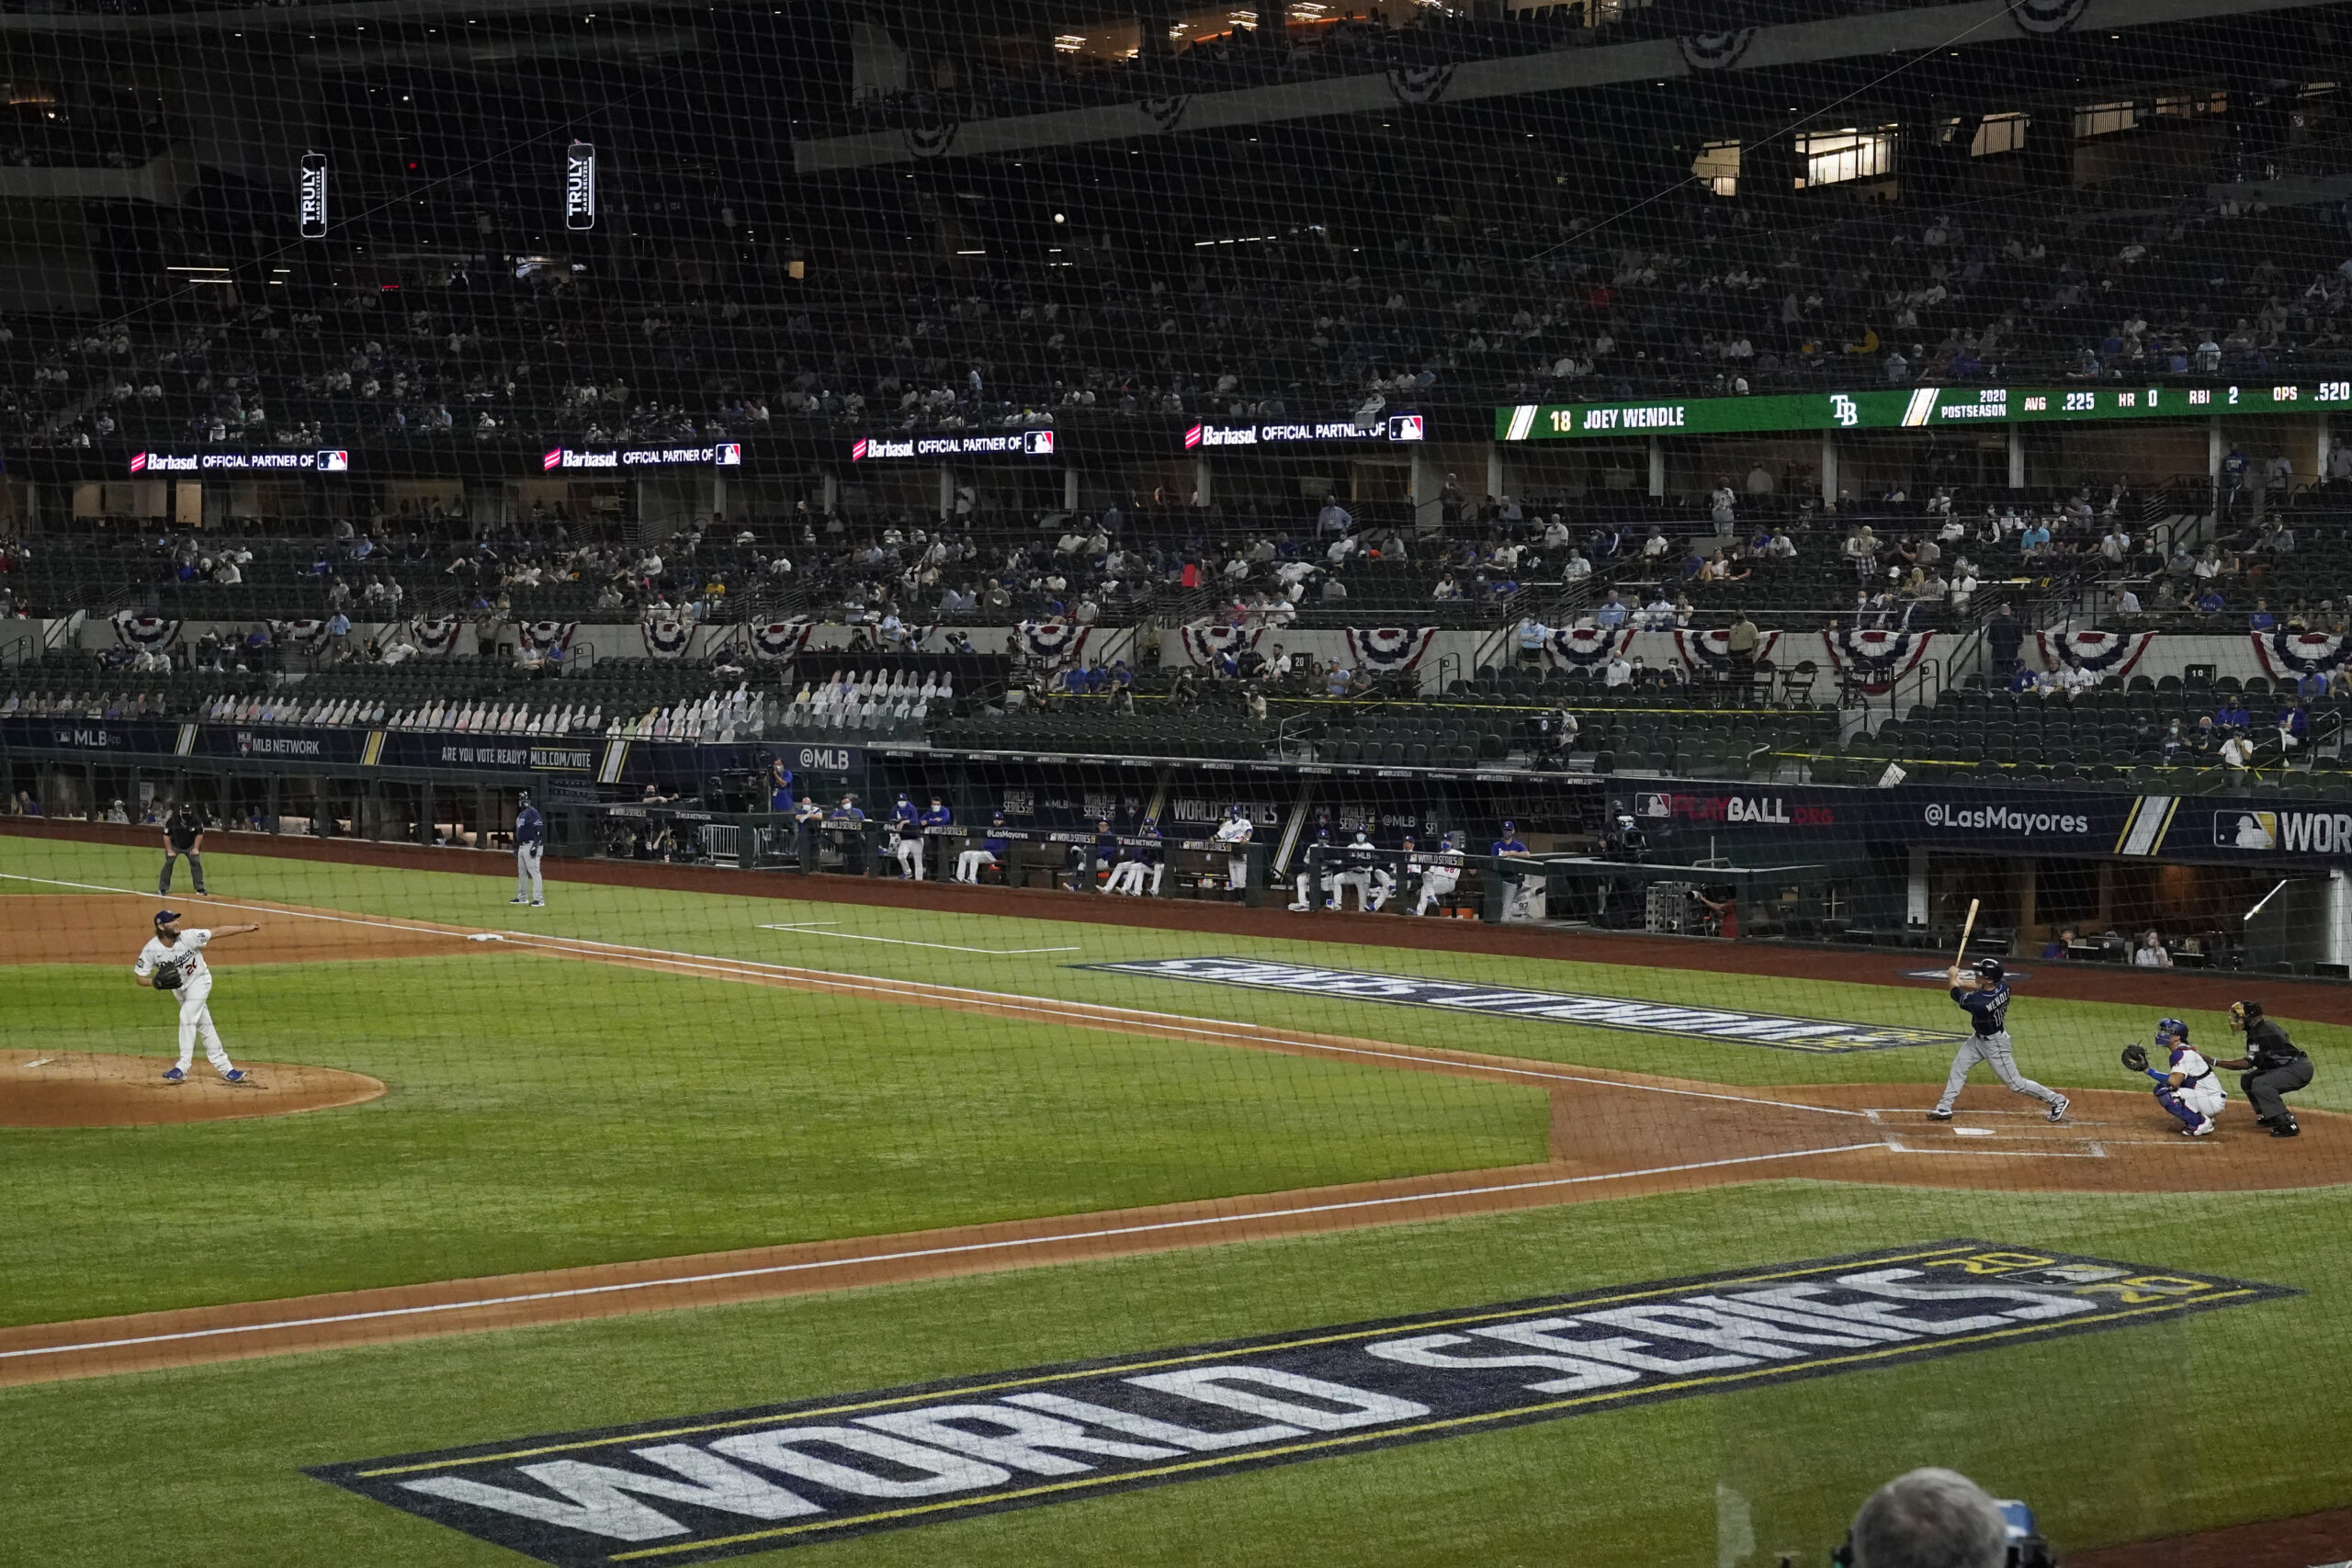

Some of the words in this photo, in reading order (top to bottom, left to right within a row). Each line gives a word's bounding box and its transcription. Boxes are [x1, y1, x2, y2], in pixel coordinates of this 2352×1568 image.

[569, 156, 582, 217] TRULY
[302, 166, 316, 225] TRULY
[1980, 389, 2007, 403] 2020
[2119, 393, 2135, 407] HR
[2148, 389, 2157, 407] 0
[2188, 389, 2211, 404] RBI
[2228, 386, 2238, 404] 2
[2273, 386, 2297, 401] OPS
[2314, 382, 2350, 400] .520
[2024, 397, 2046, 412] AVG
[2062, 392, 2095, 411] .225
[1941, 404, 2007, 419] POSTSEASON
[1550, 411, 1571, 432] 18
[1583, 409, 1619, 430] JOEY
[1623, 407, 1685, 428] WENDLE
[1203, 425, 1258, 446] Barbasol
[1261, 424, 1314, 441] OFFICIAL
[867, 439, 914, 457] Barbasol
[918, 439, 961, 454] OFFICIAL
[963, 437, 1006, 452] PARTNER
[1008, 436, 1022, 450] OF
[147, 453, 198, 470] Barbasol
[202, 455, 249, 468] OFFICIAL
[252, 455, 298, 468] PARTNER
[300, 455, 314, 468] OF
[562, 450, 618, 468] Barbasol
[623, 449, 662, 465] OFFICIAL
[662, 448, 700, 464] PARTNER
[701, 448, 714, 461] OF
[1295, 657, 1305, 667] 20
[2191, 669, 2204, 677] 10
[74, 729, 107, 747] MLB
[107, 733, 121, 745] App
[252, 739, 272, 753] MLB
[273, 739, 320, 754] NETWORK
[442, 747, 457, 761] ARE
[459, 747, 474, 762] YOU
[477, 749, 495, 763] VOTE
[497, 749, 527, 765] READY?
[530, 750, 591, 768] MLB.COM/VOTE
[800, 748, 850, 770] @MLB
[1003, 791, 1025, 802] WORLD
[1083, 795, 1107, 806] WORLD
[1003, 801, 1025, 814] SERIES
[1024, 806, 1035, 814] 20
[1051, 800, 1069, 809] MLB
[1083, 806, 1107, 818] SERIES
[1173, 799, 1218, 821] WORLD
[1488, 797, 1531, 815] WORLD
[1544, 800, 1582, 819] SERIES
[1339, 807, 1365, 818] WORLD
[1924, 804, 2088, 836] @LasMayores
[1339, 818, 1366, 830] SERIES
[1366, 824, 1375, 832] 20
[1383, 814, 1416, 828] @MLB
[931, 826, 947, 836] WORLD
[946, 827, 963, 837] SERIES
[987, 829, 1028, 840] @LasMayores
[1057, 833, 1075, 843] WORLD
[1074, 834, 1091, 844] SERIES
[2280, 811, 2352, 853] WOR
[1123, 837, 1136, 846] MLB
[1136, 838, 1162, 848] NETWORK
[1190, 840, 1209, 851] WORLD
[1356, 852, 1372, 860] MLB
[1418, 853, 1439, 863] WORLD
[1438, 855, 1458, 865] SERIES
[1519, 901, 1529, 910] 97
[1985, 987, 2010, 1012] WENDLE
[1923, 1252, 2056, 1275] 20
[2074, 1275, 2213, 1304] 20
[401, 1365, 1431, 1542] WORLD
[1363, 1268, 2098, 1393] SERIES
